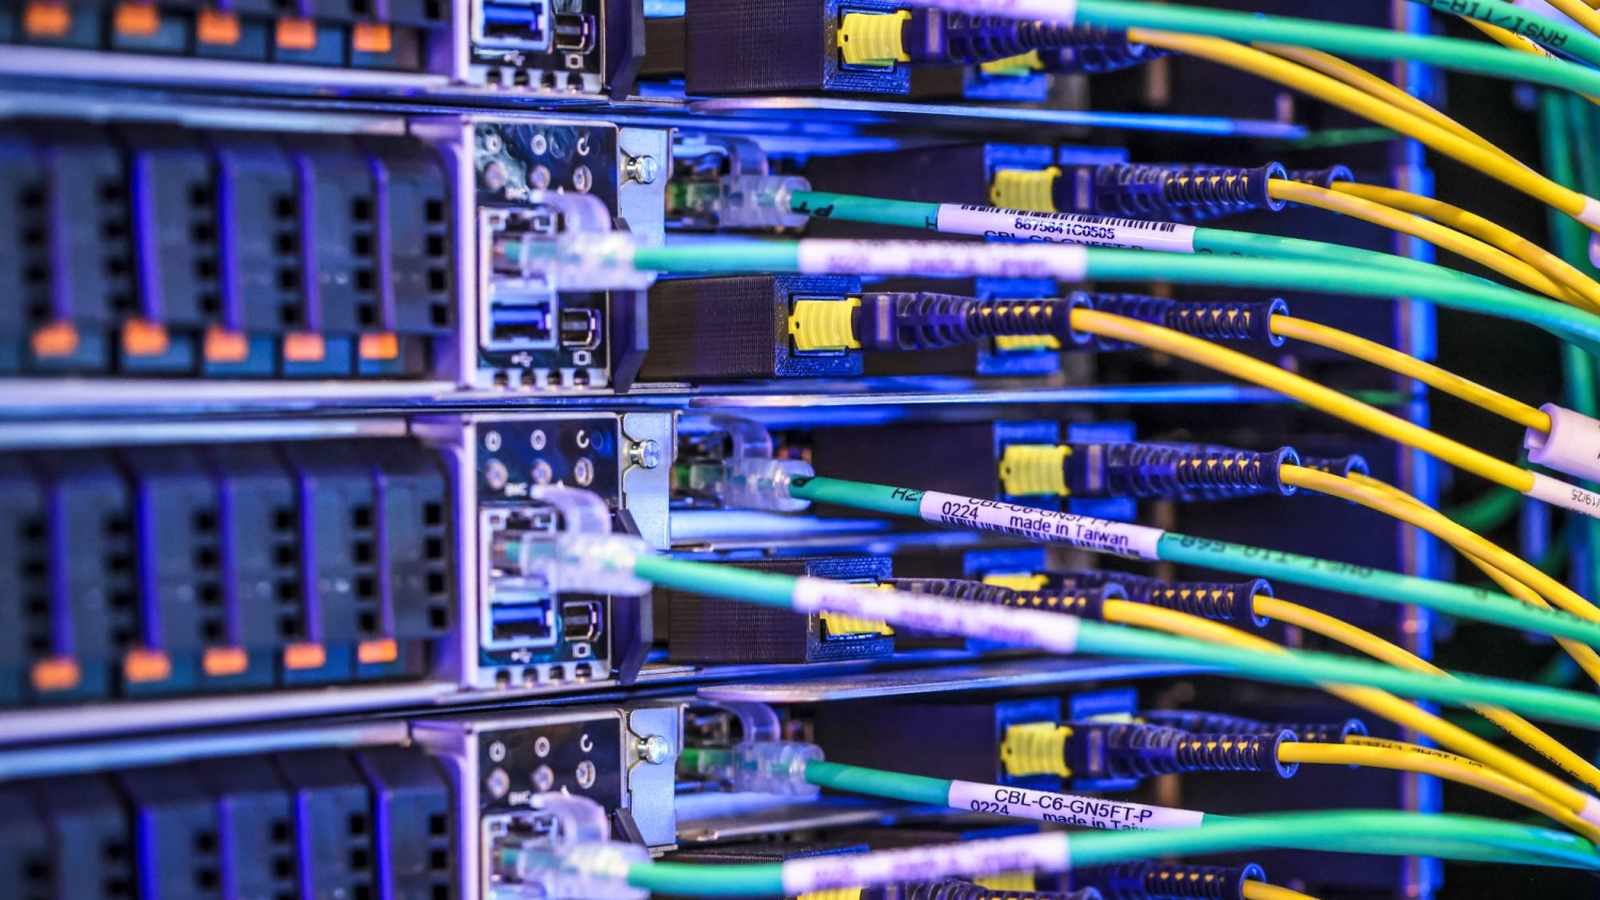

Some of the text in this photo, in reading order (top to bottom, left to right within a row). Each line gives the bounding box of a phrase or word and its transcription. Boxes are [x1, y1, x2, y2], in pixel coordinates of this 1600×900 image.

[942, 501, 1128, 546] 0224 made in Taiwan
[970, 799, 1010, 816] 0224
[994, 788, 1153, 823] CBL-C6-GN5FT-P
